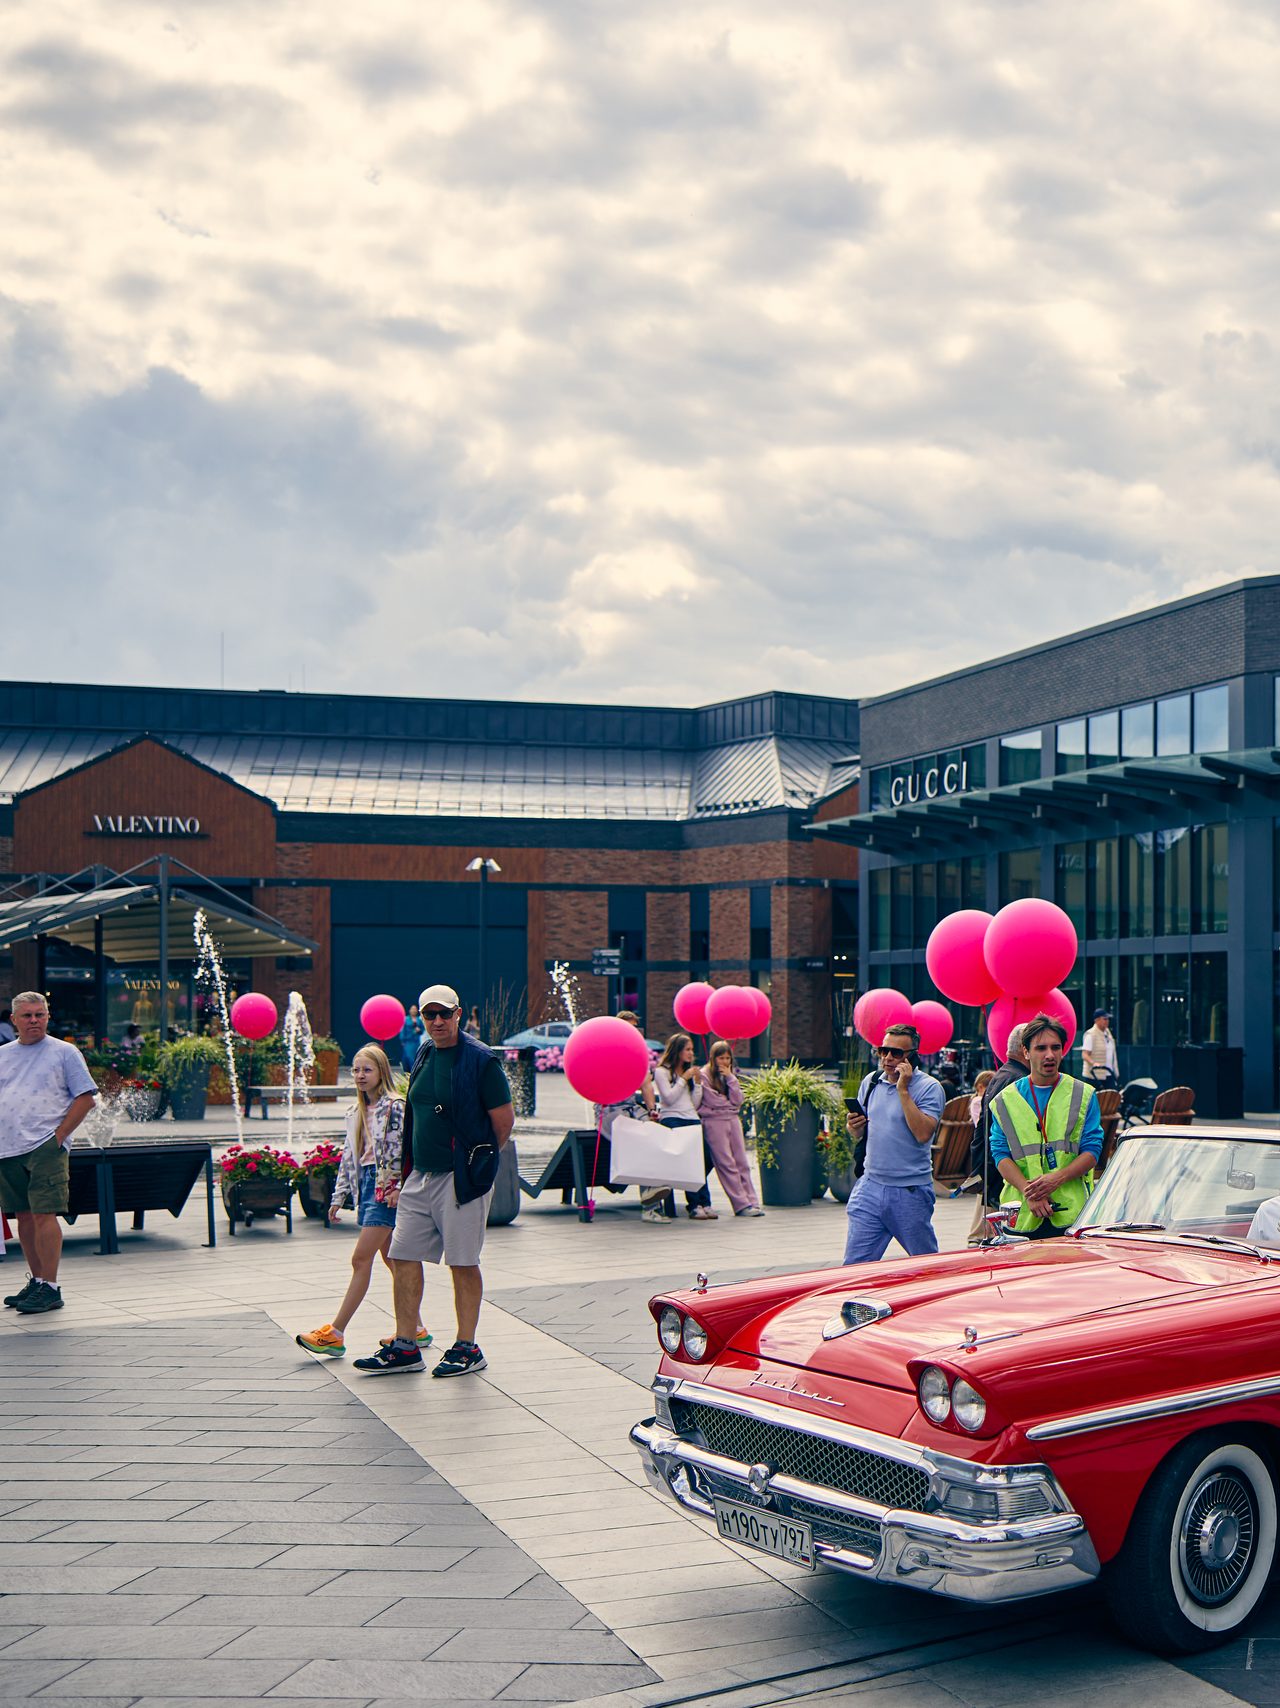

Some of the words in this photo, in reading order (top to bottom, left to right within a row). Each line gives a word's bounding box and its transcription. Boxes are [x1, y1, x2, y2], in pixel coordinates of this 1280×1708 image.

[890, 760, 967, 806] GUCCI
[93, 814, 200, 833] VALENTINO
[124, 979, 180, 990] VALENTNO
[780, 1523, 804, 1552] 797
[788, 1547, 801, 1560] RUS
